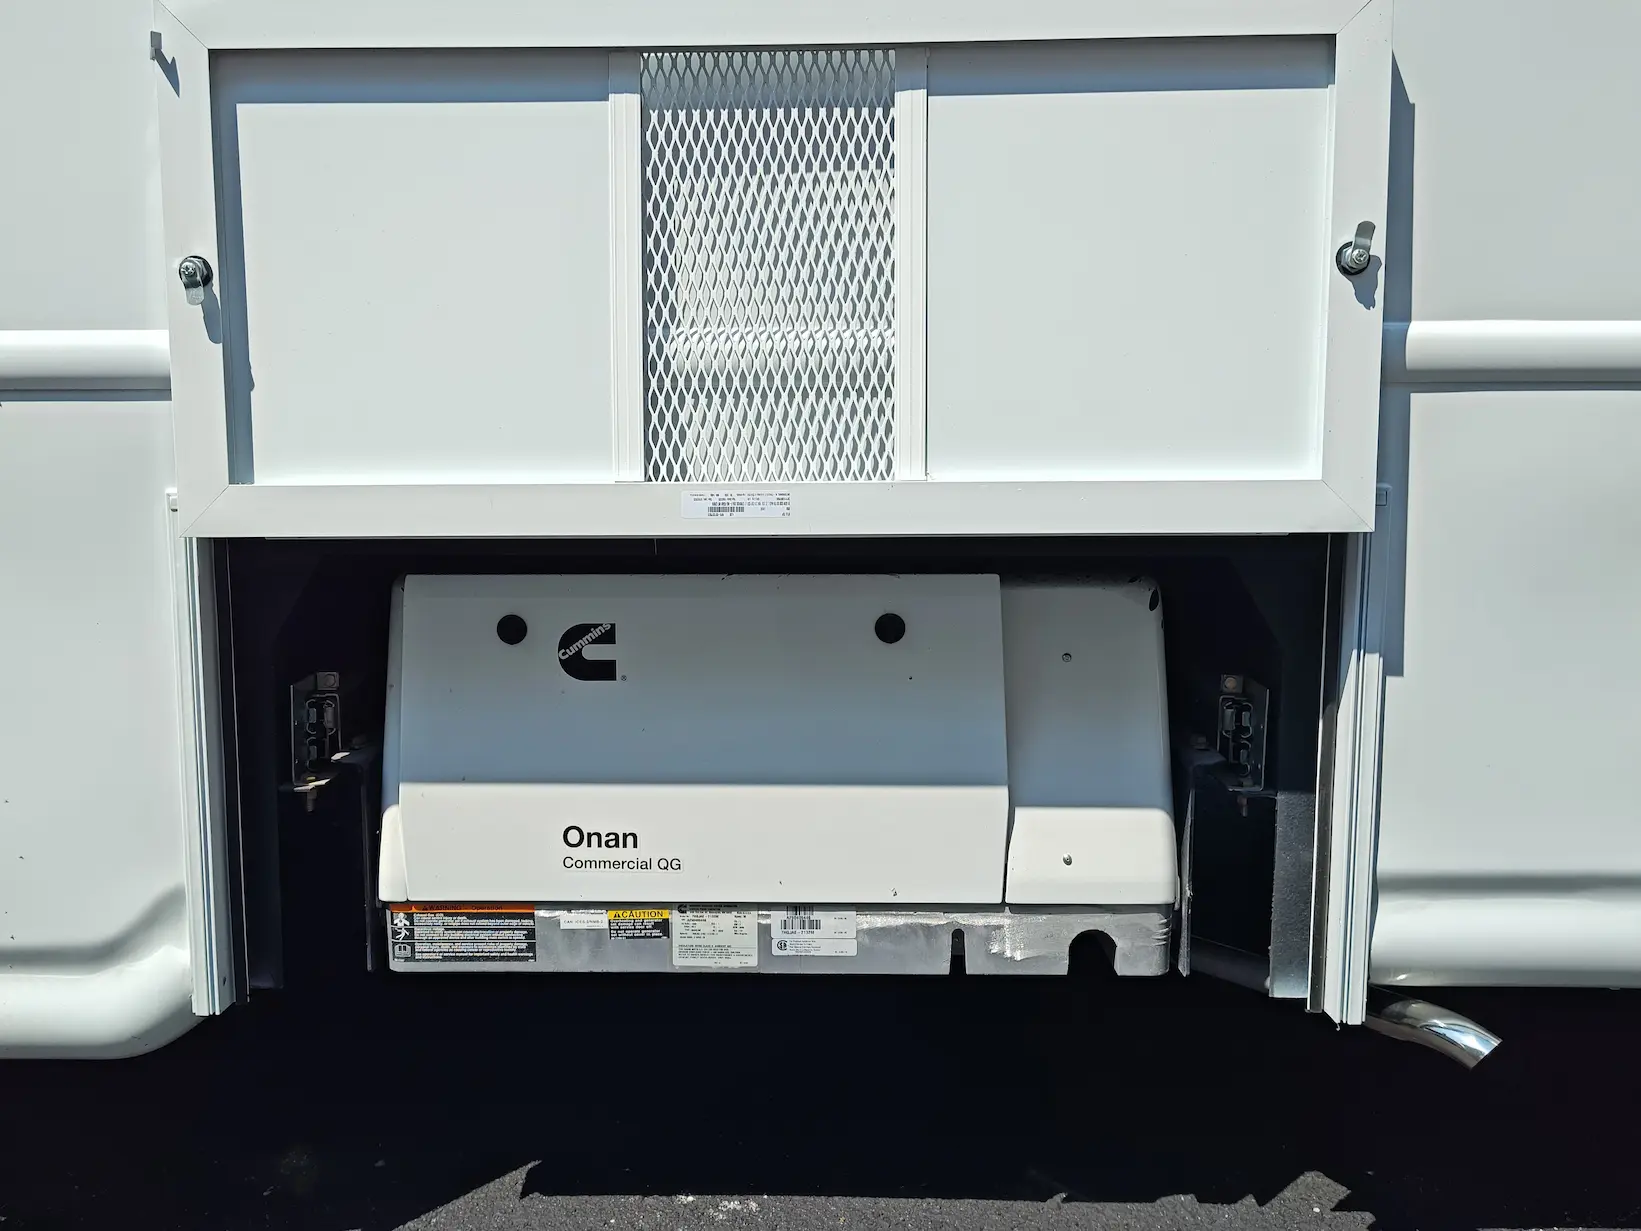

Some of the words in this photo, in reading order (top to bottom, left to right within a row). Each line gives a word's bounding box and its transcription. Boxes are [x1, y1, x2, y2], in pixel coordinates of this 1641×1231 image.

[558, 622, 611, 660] Cummins
[563, 825, 638, 849] Onan
[563, 856, 652, 870] Commercial
[657, 857, 682, 872] QG
